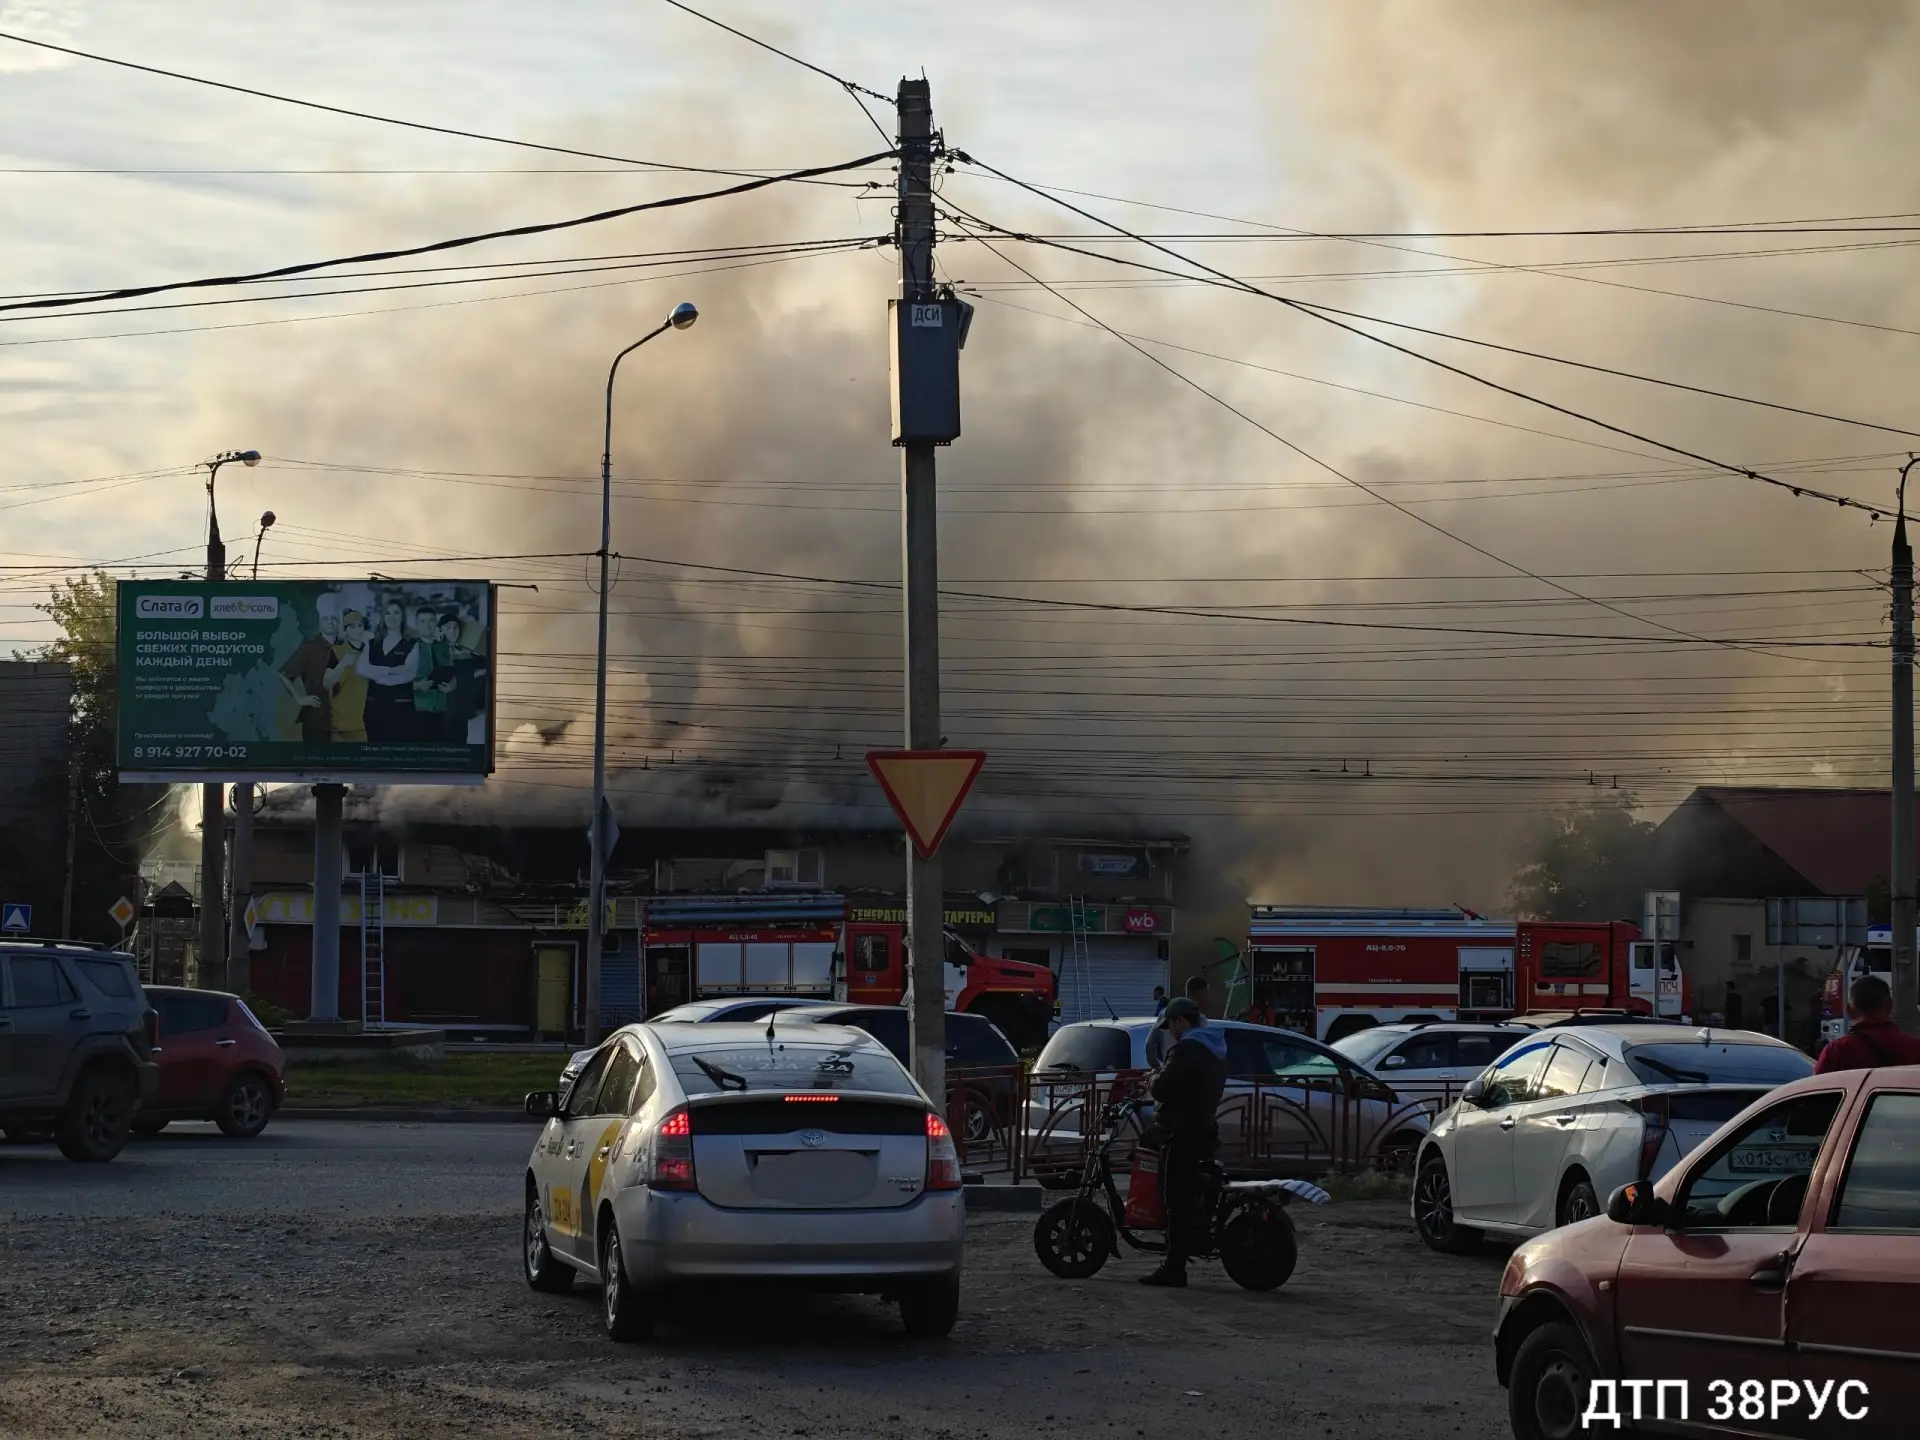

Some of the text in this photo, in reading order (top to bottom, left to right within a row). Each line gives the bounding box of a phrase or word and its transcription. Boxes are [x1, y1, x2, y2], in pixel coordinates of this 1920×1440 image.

[915, 308, 940, 323] ДСИ
[141, 600, 275, 613] Слата хлеб соль
[136, 629, 246, 641] БОЛЬШОЙ ВЫБОР
[136, 643, 264, 655] СВЕЖИХ ПРОДУКТОВ
[136, 656, 232, 668] КАЖДЫЙ ДЕНЬ!
[134, 746, 247, 758] 8 914 927 70-02
[852, 909, 995, 924] ГЕНЕРАТО ТАРТЕРЫ
[1128, 912, 1155, 928] wb
